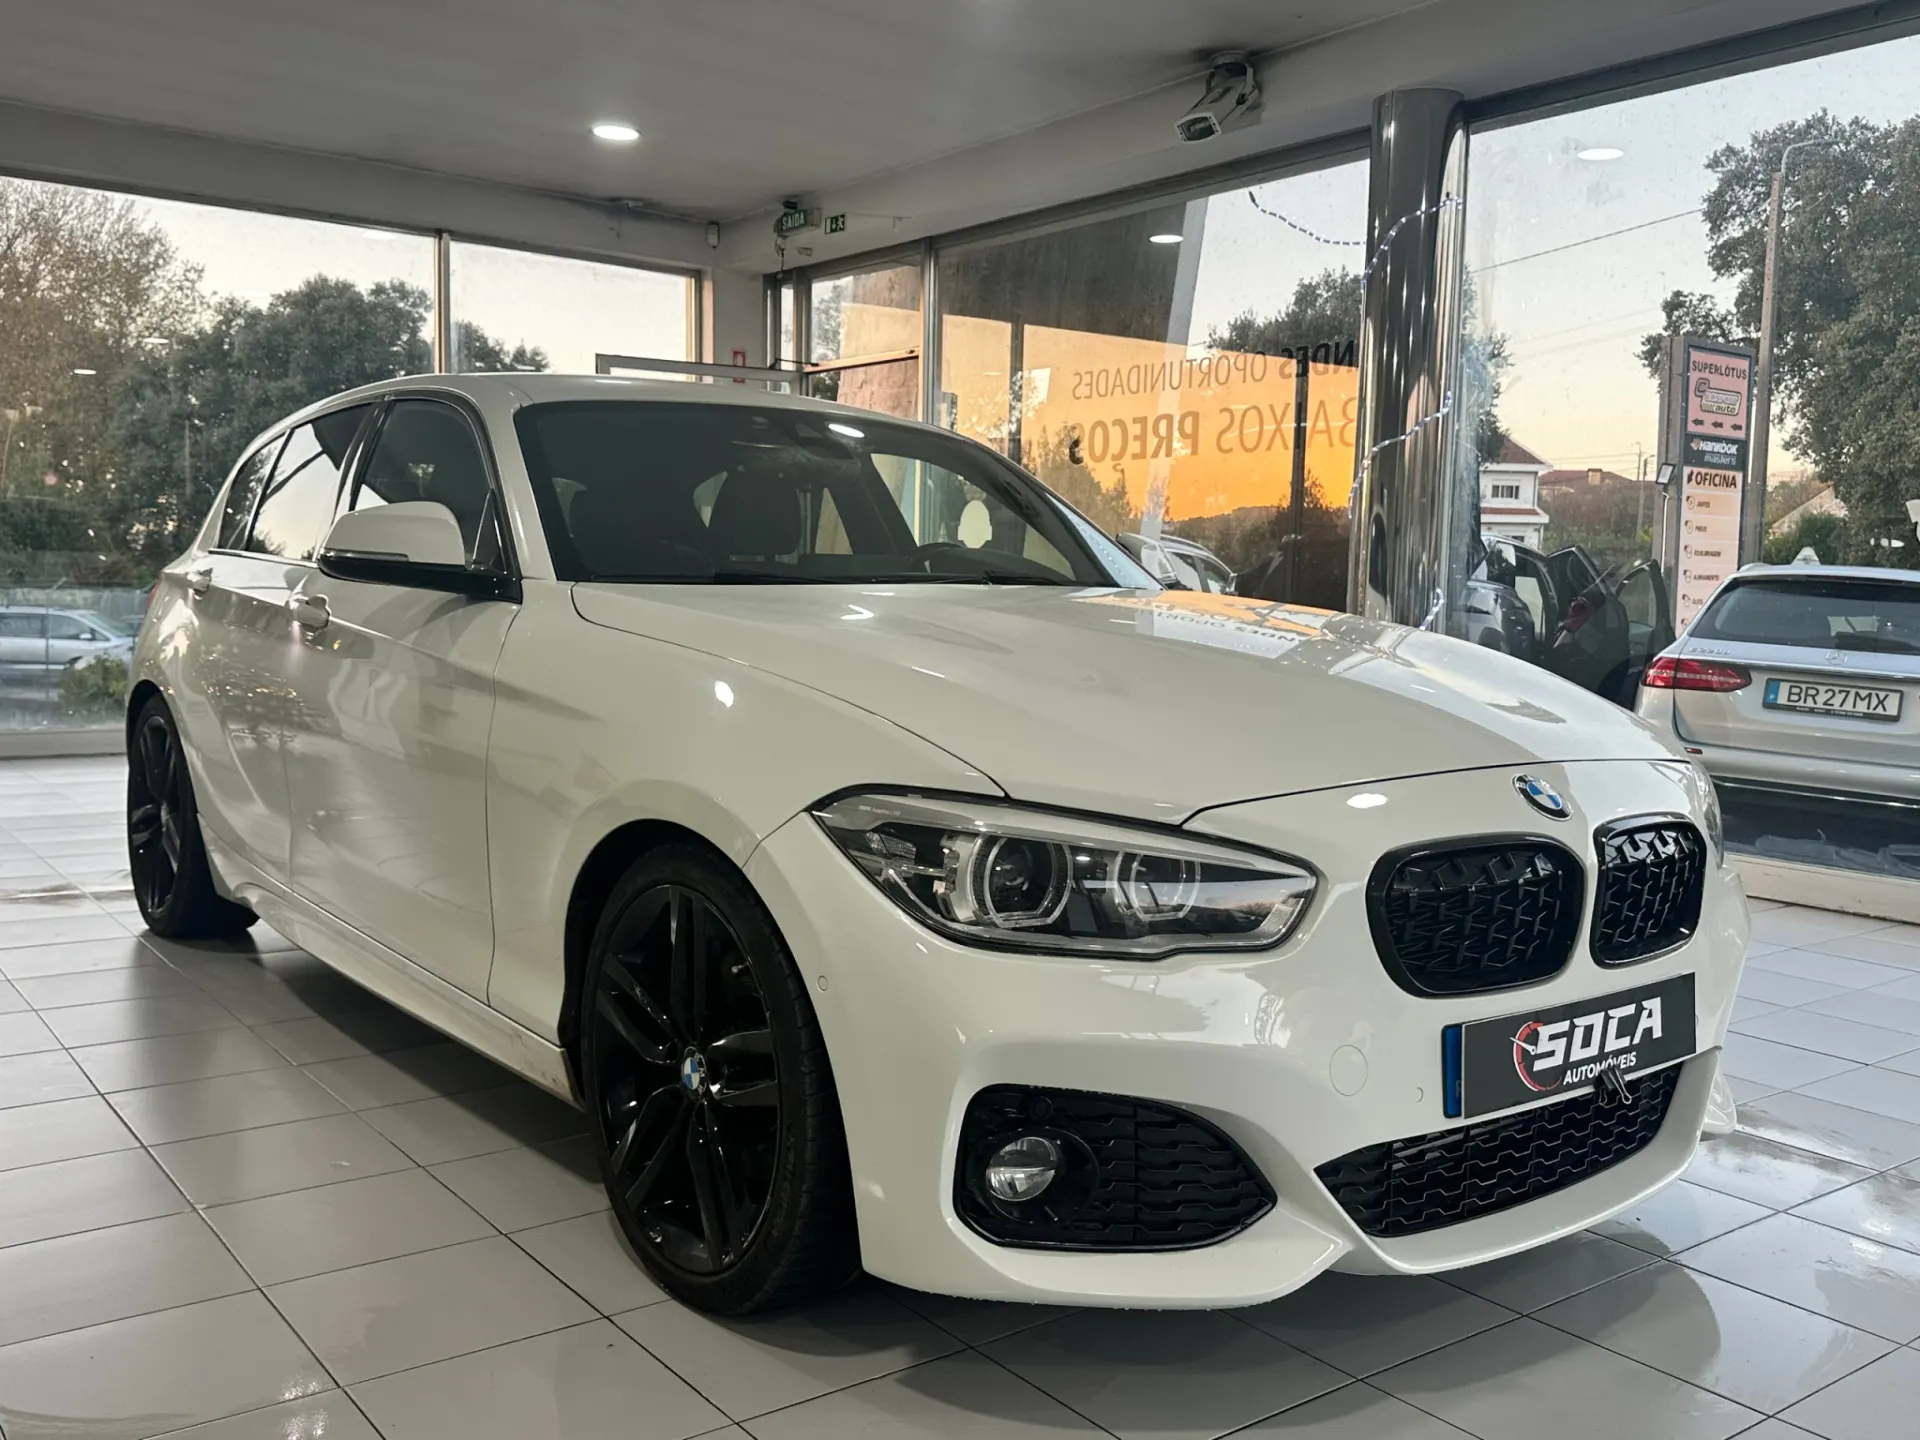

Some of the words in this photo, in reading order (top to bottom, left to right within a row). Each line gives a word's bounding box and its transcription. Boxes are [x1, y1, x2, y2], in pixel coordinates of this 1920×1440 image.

[1691, 360, 1747, 380] SUPERLÓTUS
[1695, 471, 1737, 488] OFICINA
[1786, 684, 1890, 713] BR27MX
[1533, 997, 1663, 1072] SOCA
